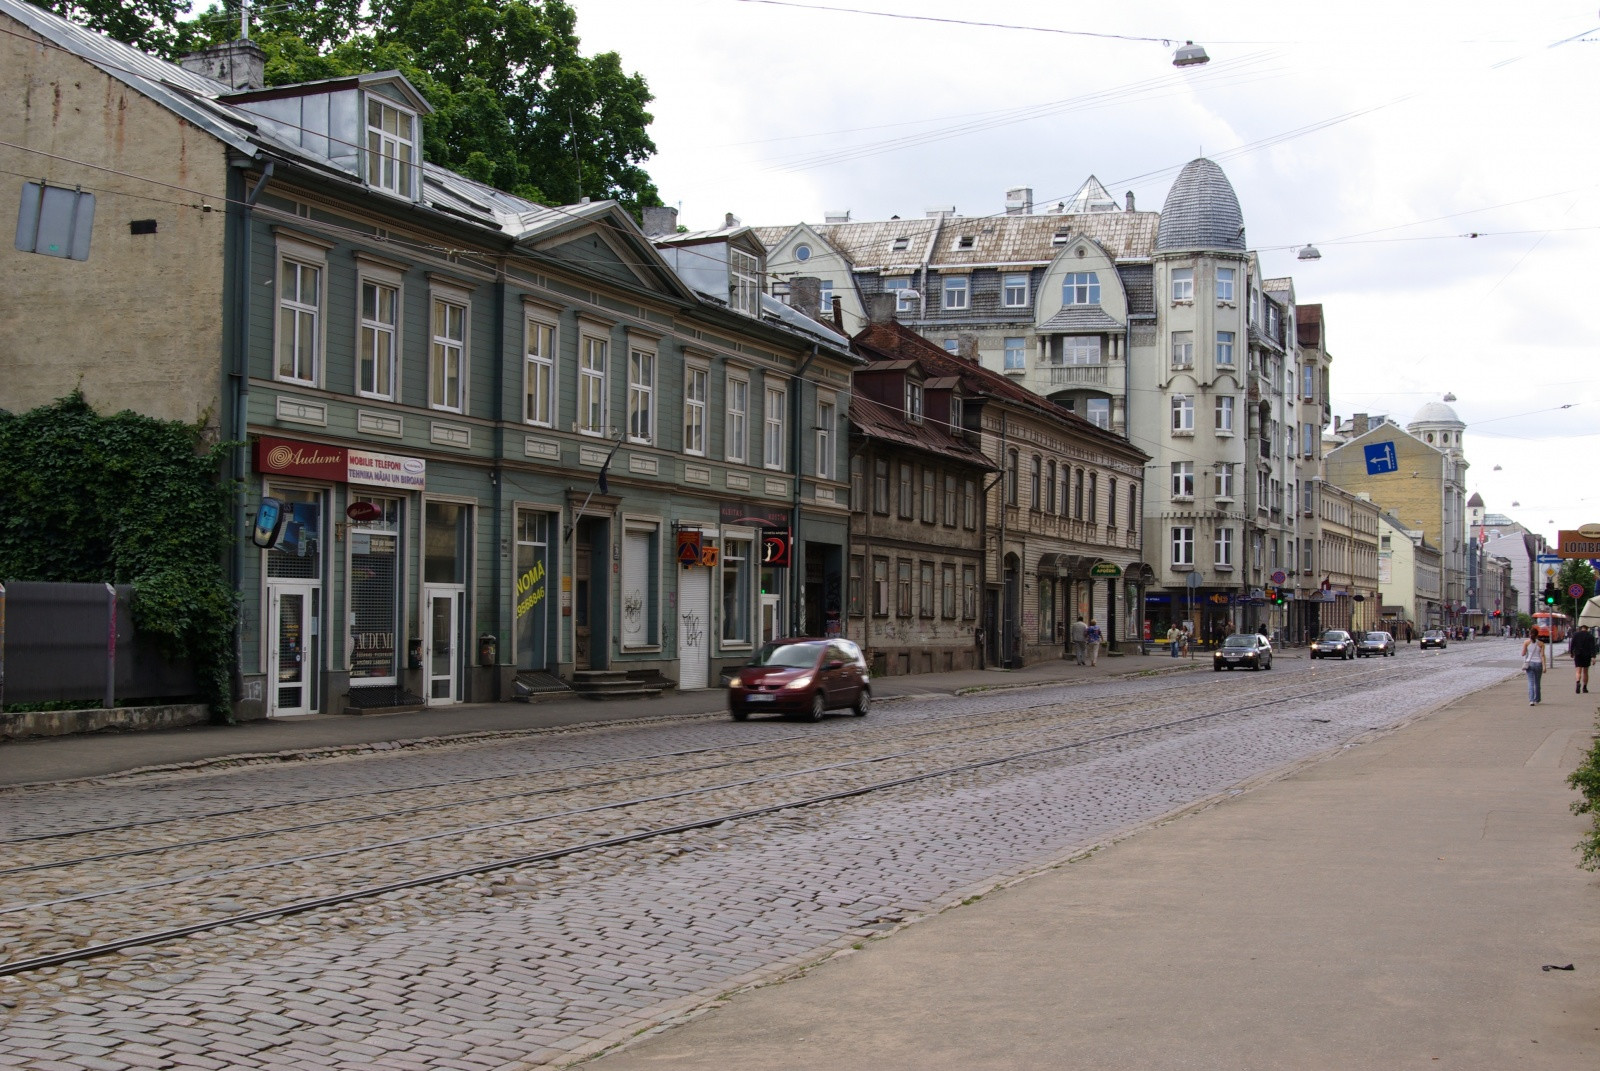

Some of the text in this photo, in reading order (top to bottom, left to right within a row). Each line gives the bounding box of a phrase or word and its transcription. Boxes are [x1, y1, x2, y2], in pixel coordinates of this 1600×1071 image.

[291, 448, 342, 466] Audumi
[349, 455, 374, 468] MOBILIE
[375, 459, 402, 471] TELEFONI
[348, 468, 374, 480] TEHNIKA
[391, 474, 400, 483] UN
[400, 475, 425, 486] BIROJAM
[516, 560, 545, 597] NOMĀ
[516, 586, 545, 619] 9568846
[356, 632, 393, 649] AUDUMI
